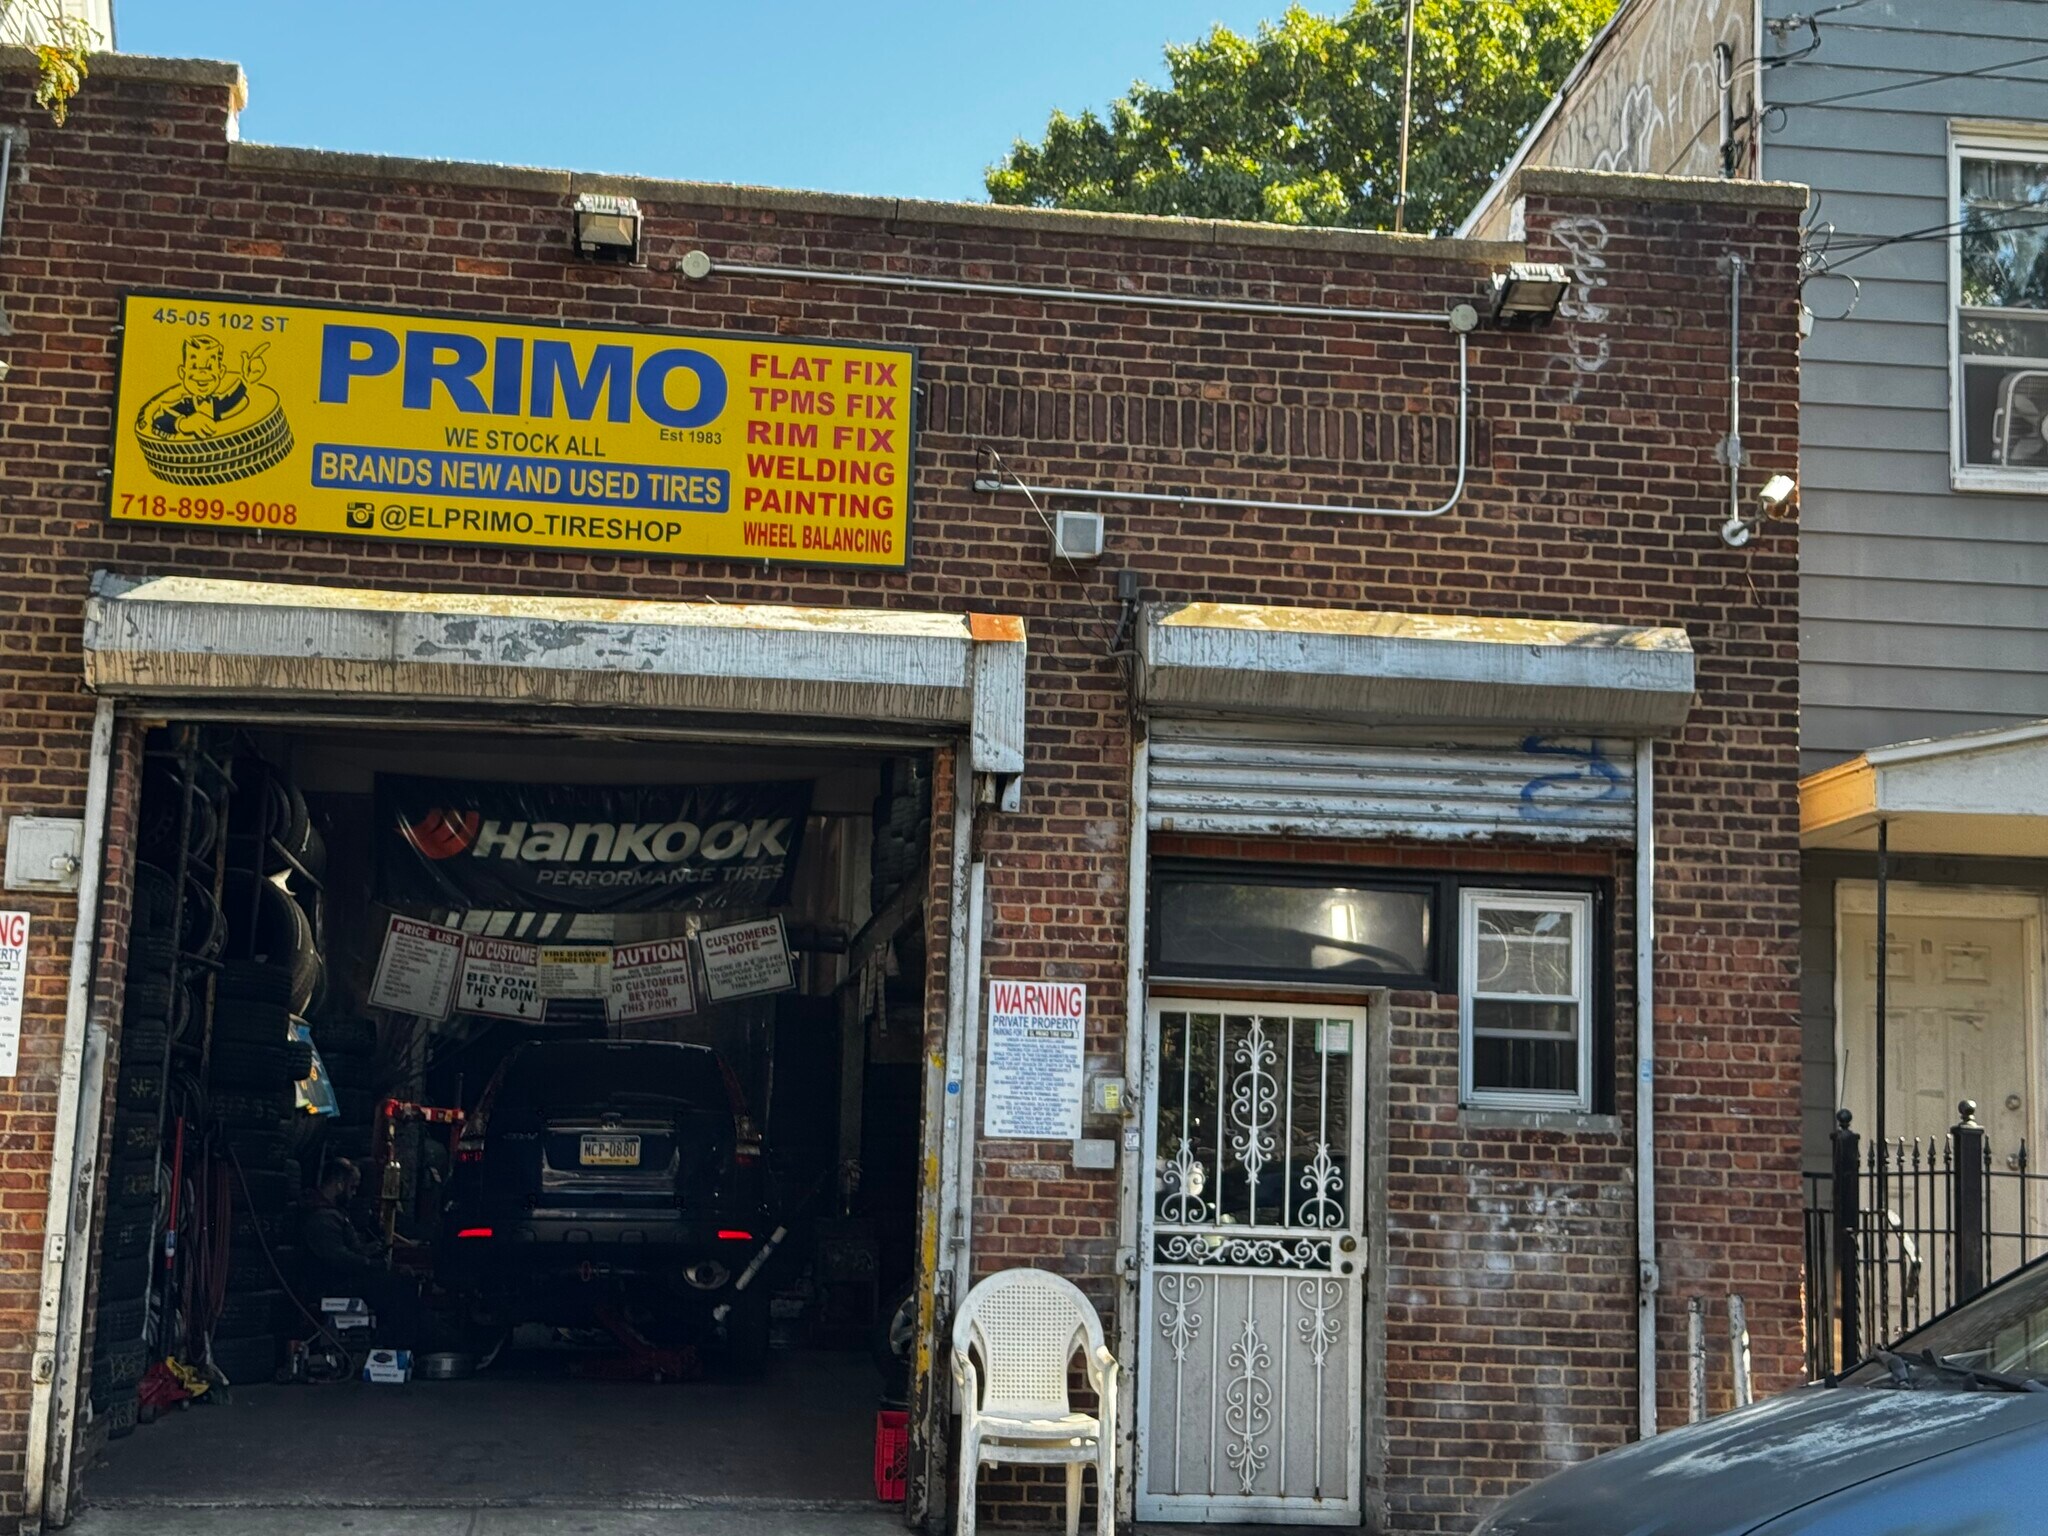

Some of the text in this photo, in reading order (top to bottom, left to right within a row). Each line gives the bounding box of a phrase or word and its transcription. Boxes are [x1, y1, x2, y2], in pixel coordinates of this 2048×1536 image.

[152, 308, 289, 333] 45-05 102 ST
[318, 323, 728, 428] PRIMO
[749, 353, 898, 388] FLAT FIX
[749, 386, 897, 421] TPMS FIX
[445, 427, 606, 457] WE STOCK ALL
[660, 428, 722, 445] Est 1983
[747, 420, 895, 454] RIM FIX
[320, 452, 721, 504] BRANDS NEW AND USED TIRES
[746, 453, 895, 487] WELDING
[120, 493, 298, 525] 718-899-9008
[744, 486, 894, 521] PAINTING
[380, 504, 682, 544] @ELPRIMO_TIRESHOP
[743, 521, 893, 555] WHEEL BALANCING
[536, 863, 787, 887] PERFORMANCE TIRES
[396, 921, 459, 946] PRICE LIST
[705, 924, 777, 949] CUSTOMERS
[467, 940, 537, 964] NO CUSTOME
[615, 942, 685, 967] AUTION
[727, 940, 760, 956] NOTE
[466, 983, 496, 997] THIS
[625, 974, 686, 991] CUSTOMERS
[628, 988, 668, 1002] BEYOND
[622, 997, 678, 1014] THIS POINT
[994, 983, 1082, 1017] WARNING
[992, 1015, 1080, 1030] PRIVATE PROPERTY
